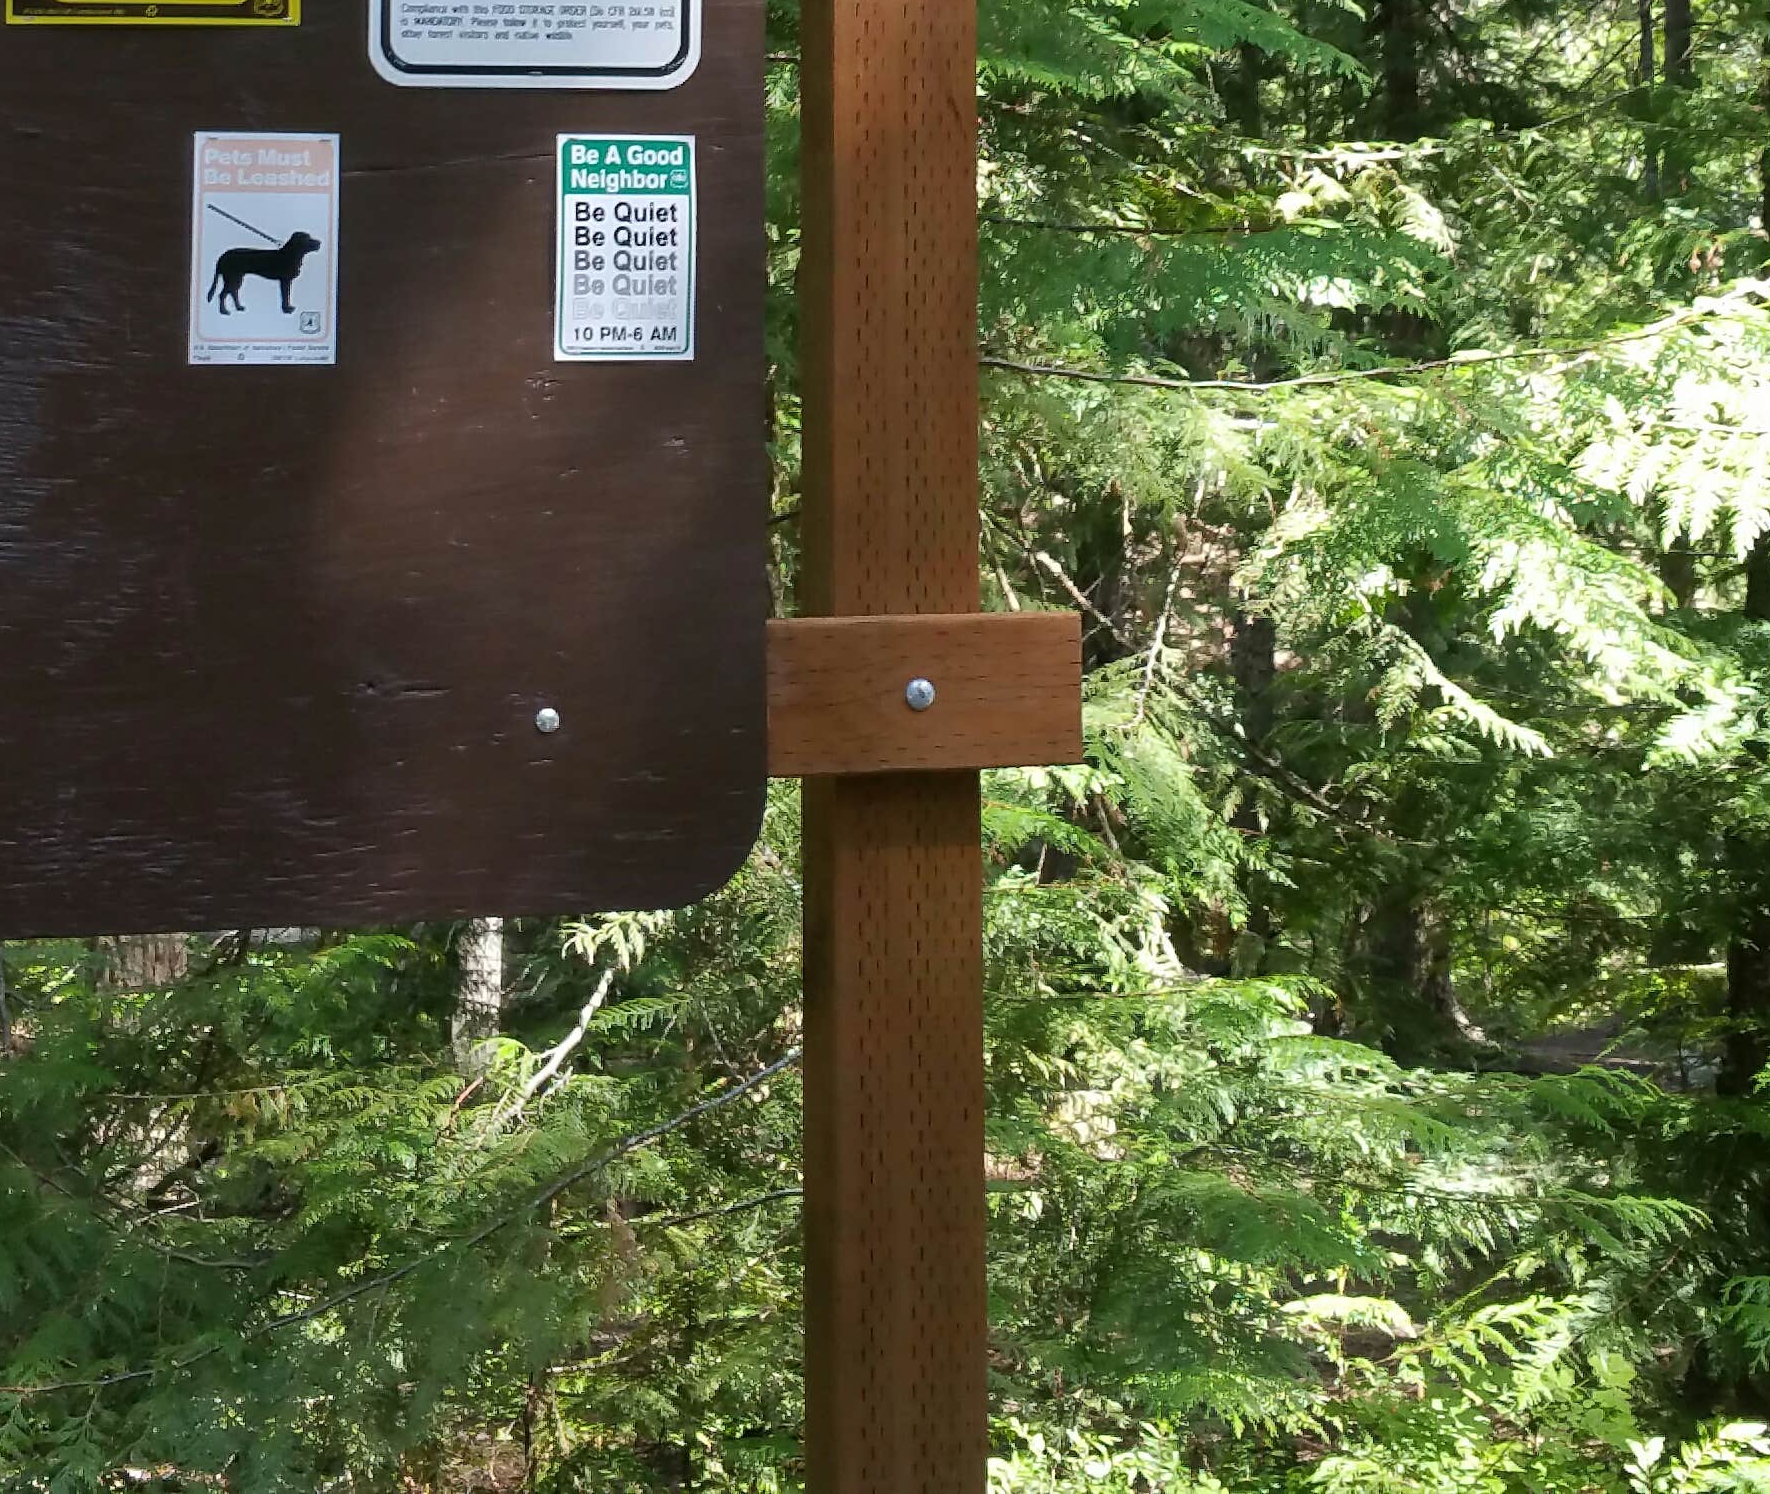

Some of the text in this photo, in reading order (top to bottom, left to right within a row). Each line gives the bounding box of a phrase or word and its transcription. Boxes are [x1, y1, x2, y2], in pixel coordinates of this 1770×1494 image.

[205, 149, 310, 166] Pets Must
[571, 145, 683, 165] Be A Good
[204, 169, 329, 186] Be Leashed
[571, 169, 667, 193] Neighbor
[575, 202, 677, 224] Be Quiet
[575, 226, 677, 248] Be Quiet
[575, 249, 677, 272] Be Quiet
[575, 273, 677, 297] Be Quiet
[575, 326, 677, 341] 10 PM-6 AM
